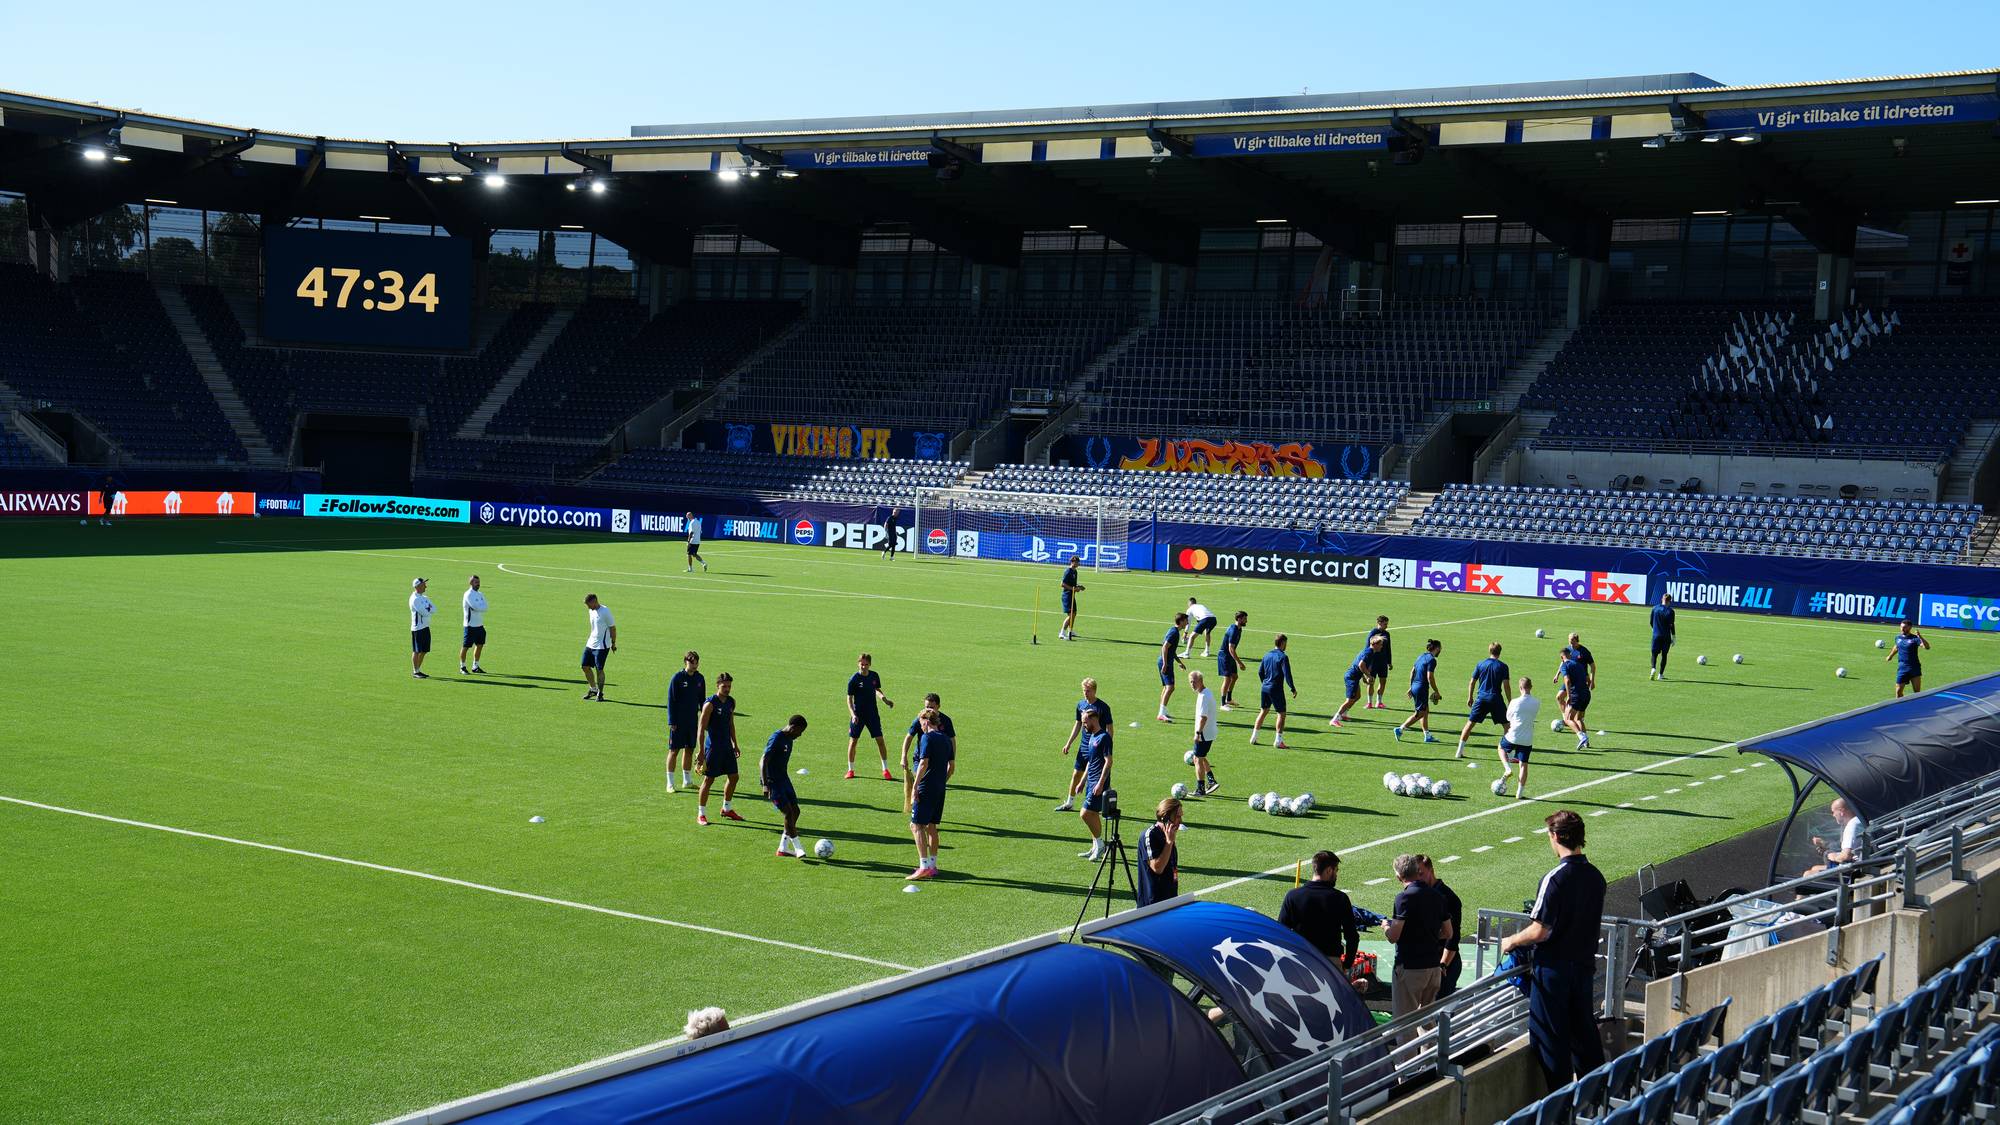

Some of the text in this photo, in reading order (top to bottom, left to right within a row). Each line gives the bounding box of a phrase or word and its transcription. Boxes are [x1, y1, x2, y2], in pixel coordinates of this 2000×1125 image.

[1758, 103, 1955, 128] Vi gir tilbake til idretten
[1233, 131, 1382, 151] Vi gir tilbake til idretten
[814, 152, 825, 164] Vi
[825, 152, 841, 166] gir
[841, 151, 877, 163] tilbake
[878, 150, 889, 162] til
[296, 266, 440, 313] 47:34
[770, 423, 891, 459] VIKING FK
[0, 493, 81, 512] AIRWAYS
[258, 498, 301, 511] #FOOTBALL
[325, 498, 461, 519] FollowScores.com
[500, 505, 601, 528] crypto.com
[640, 514, 684, 533] WELCOME
[722, 519, 778, 539] #FOOTBALL
[1056, 541, 1121, 563] PS5
[1215, 551, 1369, 580] mastercard
[1415, 559, 1504, 595] FedEx
[1537, 567, 1631, 604] FedEx
[1666, 581, 1773, 609] WELCOME ALL
[1808, 590, 1907, 619] #FOOTBALL
